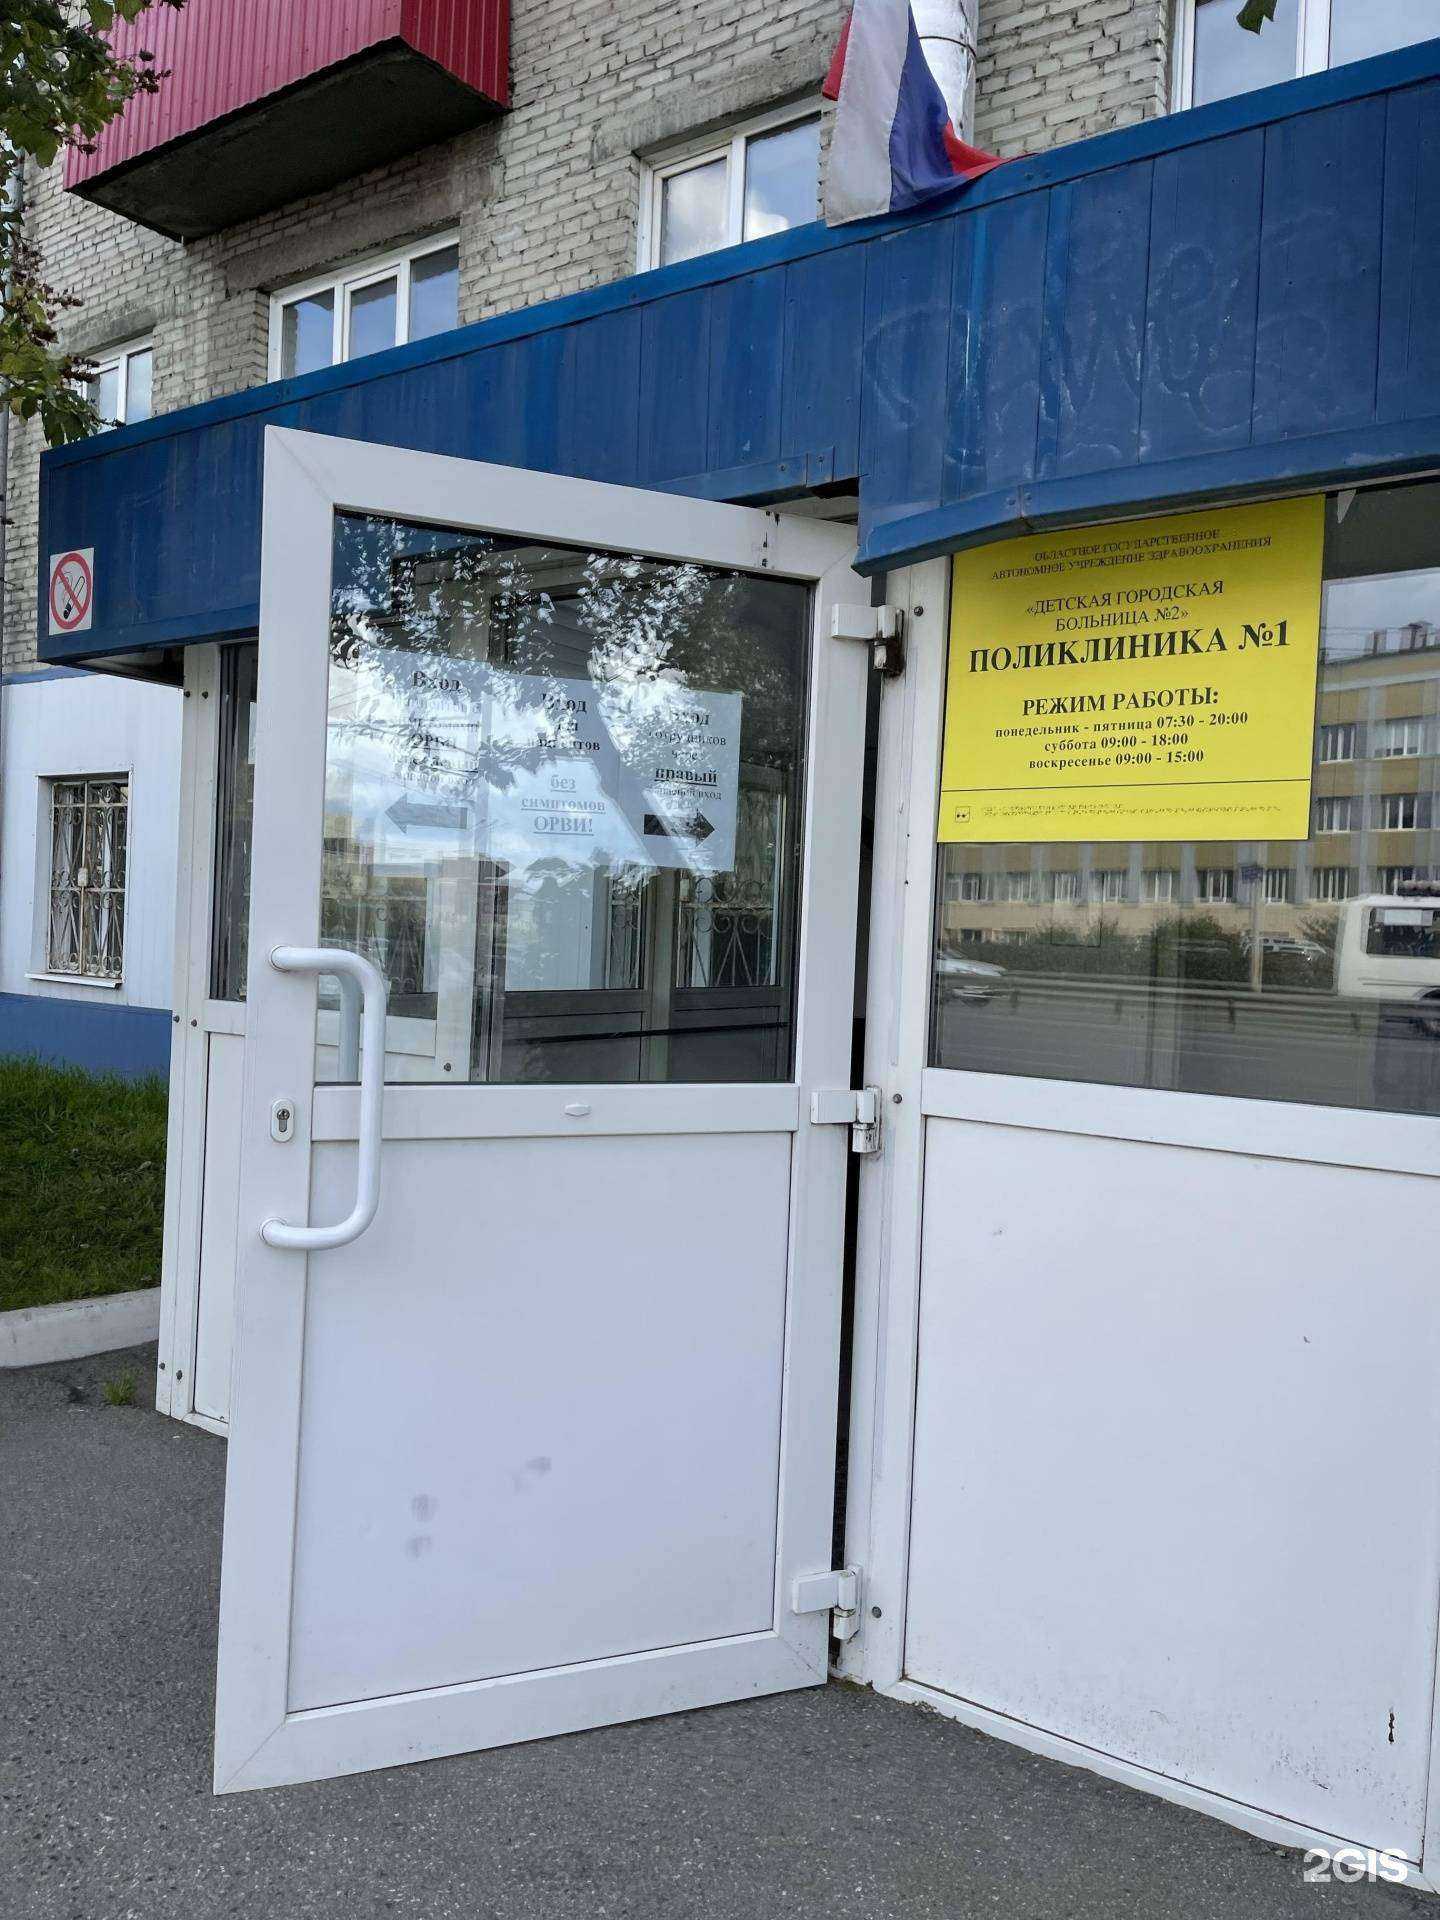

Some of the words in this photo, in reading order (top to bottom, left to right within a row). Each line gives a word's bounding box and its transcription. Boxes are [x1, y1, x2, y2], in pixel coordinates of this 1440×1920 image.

[992, 563, 1065, 580] АВТОНОМНОЕ
[1068, 552, 1145, 570] УЧРЕЖДЕНИЕ
[1149, 536, 1272, 561] ЗДРАВООХРАНЕНИЯ
[1034, 544, 1100, 562] ОБЛАСТНОЕ
[1102, 528, 1221, 553] ГОСУДАРСТВЕННОЕ
[1026, 592, 1112, 616] «ДЕТСКАЯ
[1116, 580, 1224, 605] ГОРОДСКАЯ
[1056, 609, 1150, 632] БОЛЬНИЦА
[1154, 606, 1189, 622] №2»
[969, 627, 1228, 673] ПОЛИКЛИНИКА
[1238, 620, 1290, 650] №1
[1022, 694, 1106, 716] РЕЖИМ
[1111, 687, 1219, 711] РАБОТЫ:
[995, 725, 1080, 738] понедельник
[1093, 720, 1152, 732] пятница
[1156, 714, 1195, 729] 07:30
[1208, 711, 1248, 726] 20:00
[1044, 739, 1097, 754] суббота
[1101, 735, 1137, 749] 09:00
[1151, 733, 1189, 747] 18:00
[1029, 756, 1112, 771] воскресенье
[1115, 752, 1152, 766] 09:00
[1166, 750, 1204, 764] 15:00
[550, 774, 577, 790] без
[533, 815, 594, 834] ОРВИ!
